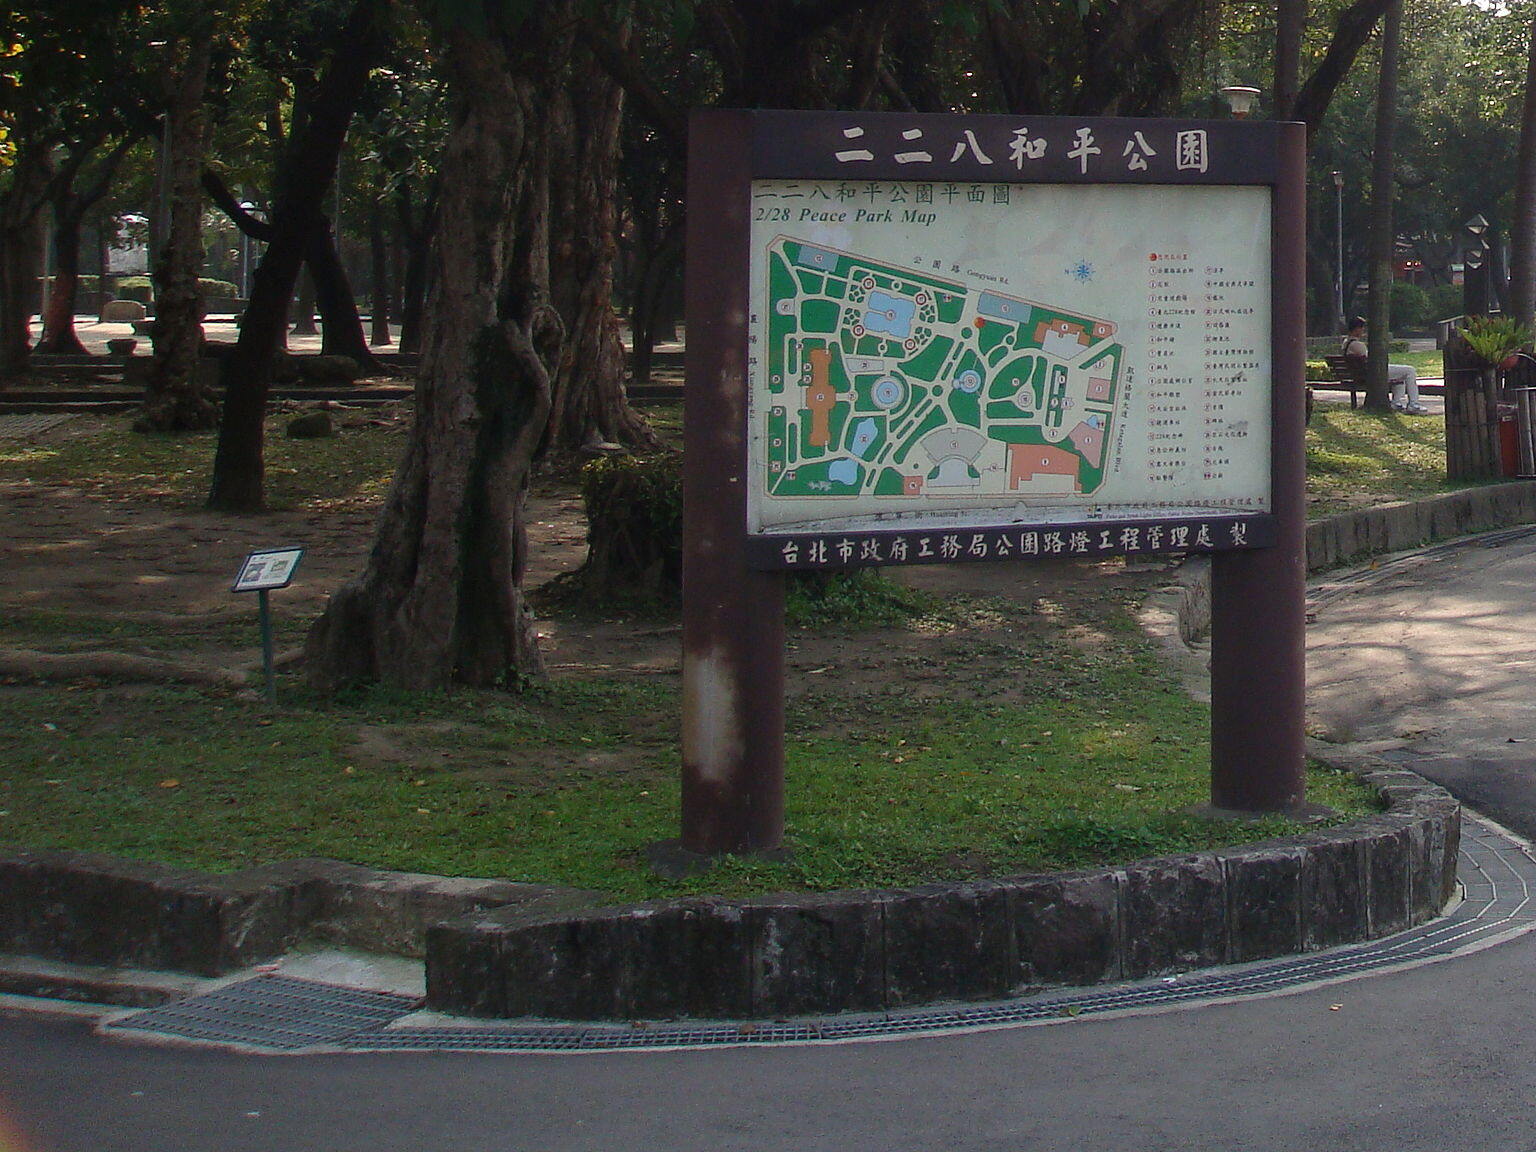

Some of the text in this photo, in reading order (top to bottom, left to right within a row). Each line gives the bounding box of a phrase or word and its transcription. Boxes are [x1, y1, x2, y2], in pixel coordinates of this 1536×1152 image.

[835, 126, 1209, 175] 二二八和平公園
[754, 182, 1010, 205] 二二八和平公園平面圖
[755, 207, 936, 227] 2/28 Peace Park Map
[781, 522, 1248, 564] 台北市政府工務局公園路燈工程管理處 製
